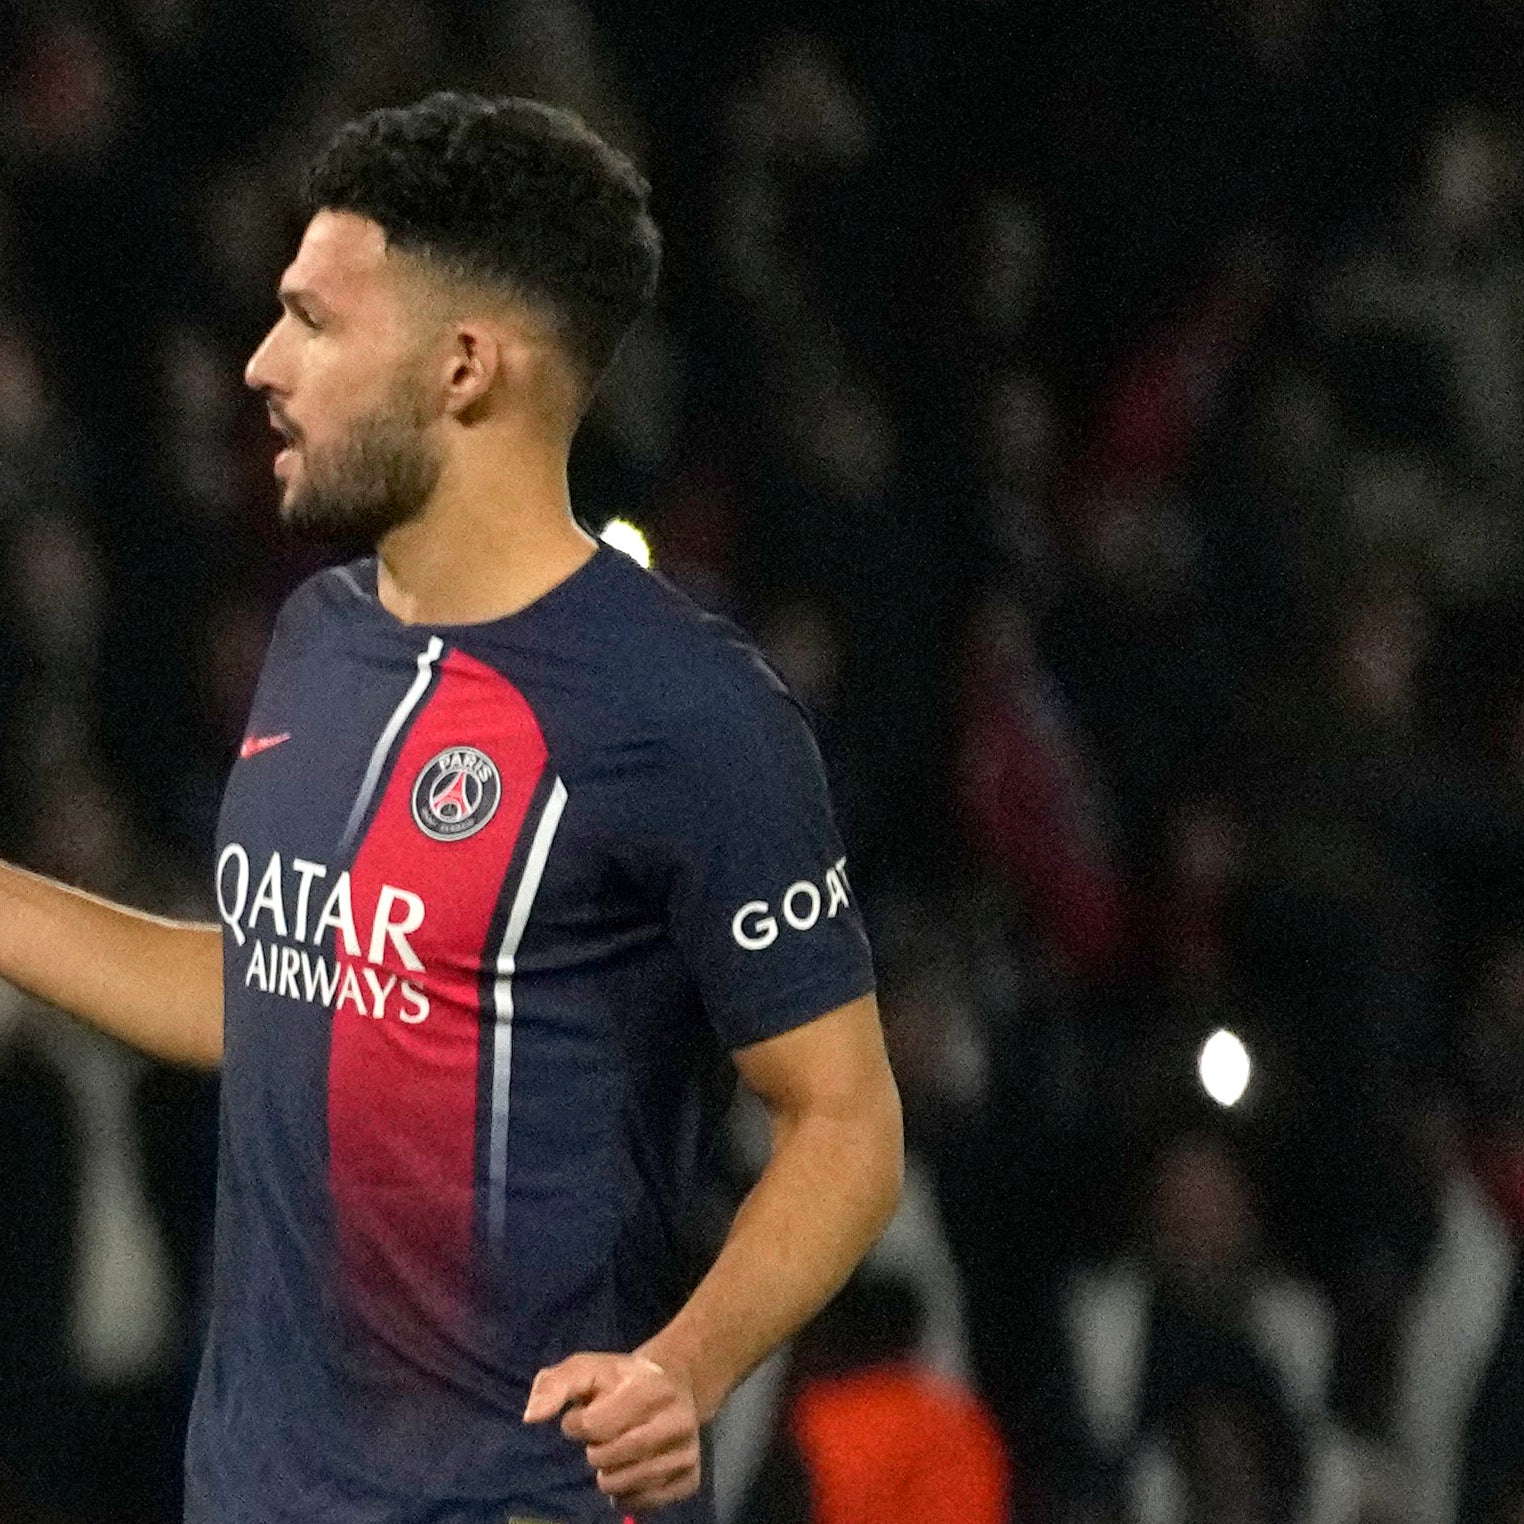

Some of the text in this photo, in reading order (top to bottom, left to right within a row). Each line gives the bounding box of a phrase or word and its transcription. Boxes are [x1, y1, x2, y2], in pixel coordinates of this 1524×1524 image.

[438, 752, 492, 782] PARIS
[216, 842, 426, 974] QATAR
[244, 939, 431, 1025] AIRWAYS
